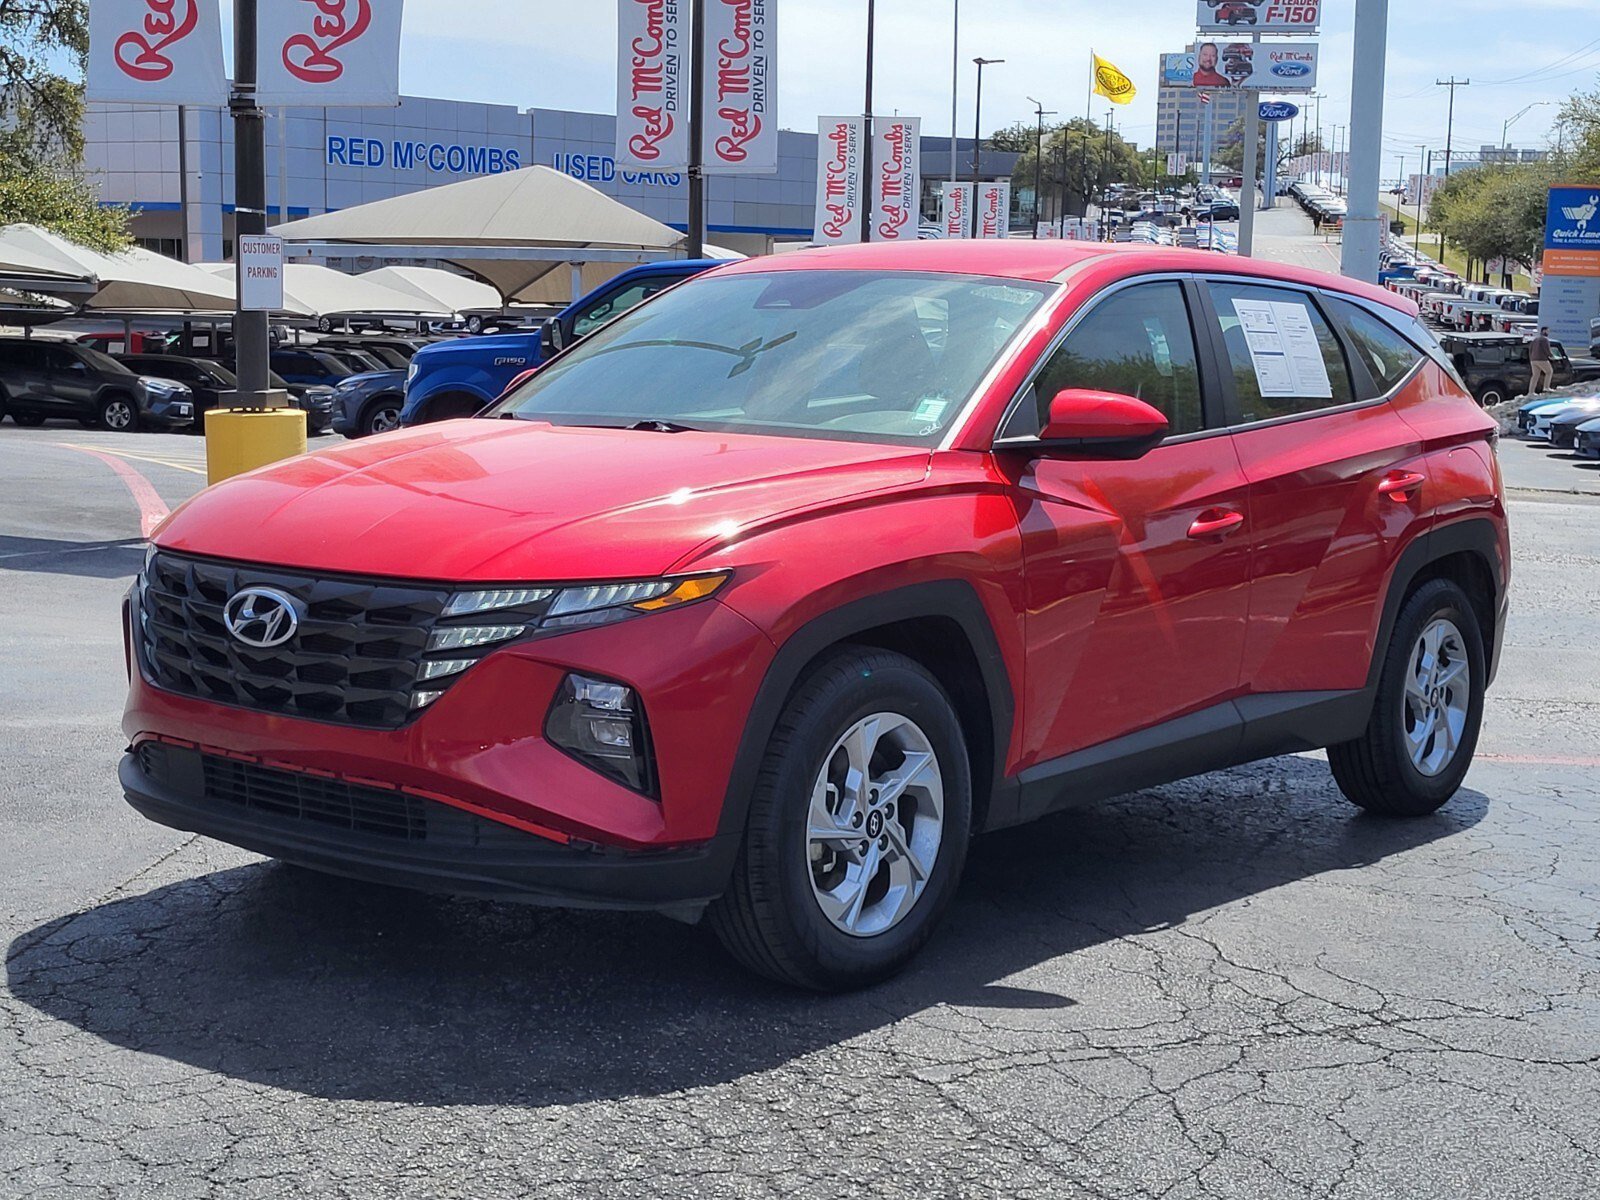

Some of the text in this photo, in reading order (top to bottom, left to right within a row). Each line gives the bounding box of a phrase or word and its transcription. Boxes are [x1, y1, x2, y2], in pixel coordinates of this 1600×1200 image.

[666, 29, 677, 49] TO
[753, 29, 765, 50] TO
[1265, 7, 1317, 23] F-150
[629, 0, 673, 161] Red McCom
[666, 55, 677, 111] DRIVEN
[715, 0, 761, 162] Red McCom
[753, 56, 764, 112] DRIVEN
[1278, 64, 1303, 75] Ford
[1260, 105, 1289, 117] Ford
[328, 136, 384, 165] RED
[554, 152, 615, 181] USED
[823, 123, 852, 238] Red McCombs
[848, 124, 857, 208] DRIVEN TO SERVE
[879, 123, 908, 239] Red McCombs
[903, 124, 913, 209] DRIVEN TO SERVE
[948, 187, 961, 237] McCombs
[983, 188, 997, 238] McCombs
[1552, 229, 1579, 238] Quick
[243, 243, 280, 254] CUSTOMER
[248, 267, 277, 278] PARKING
